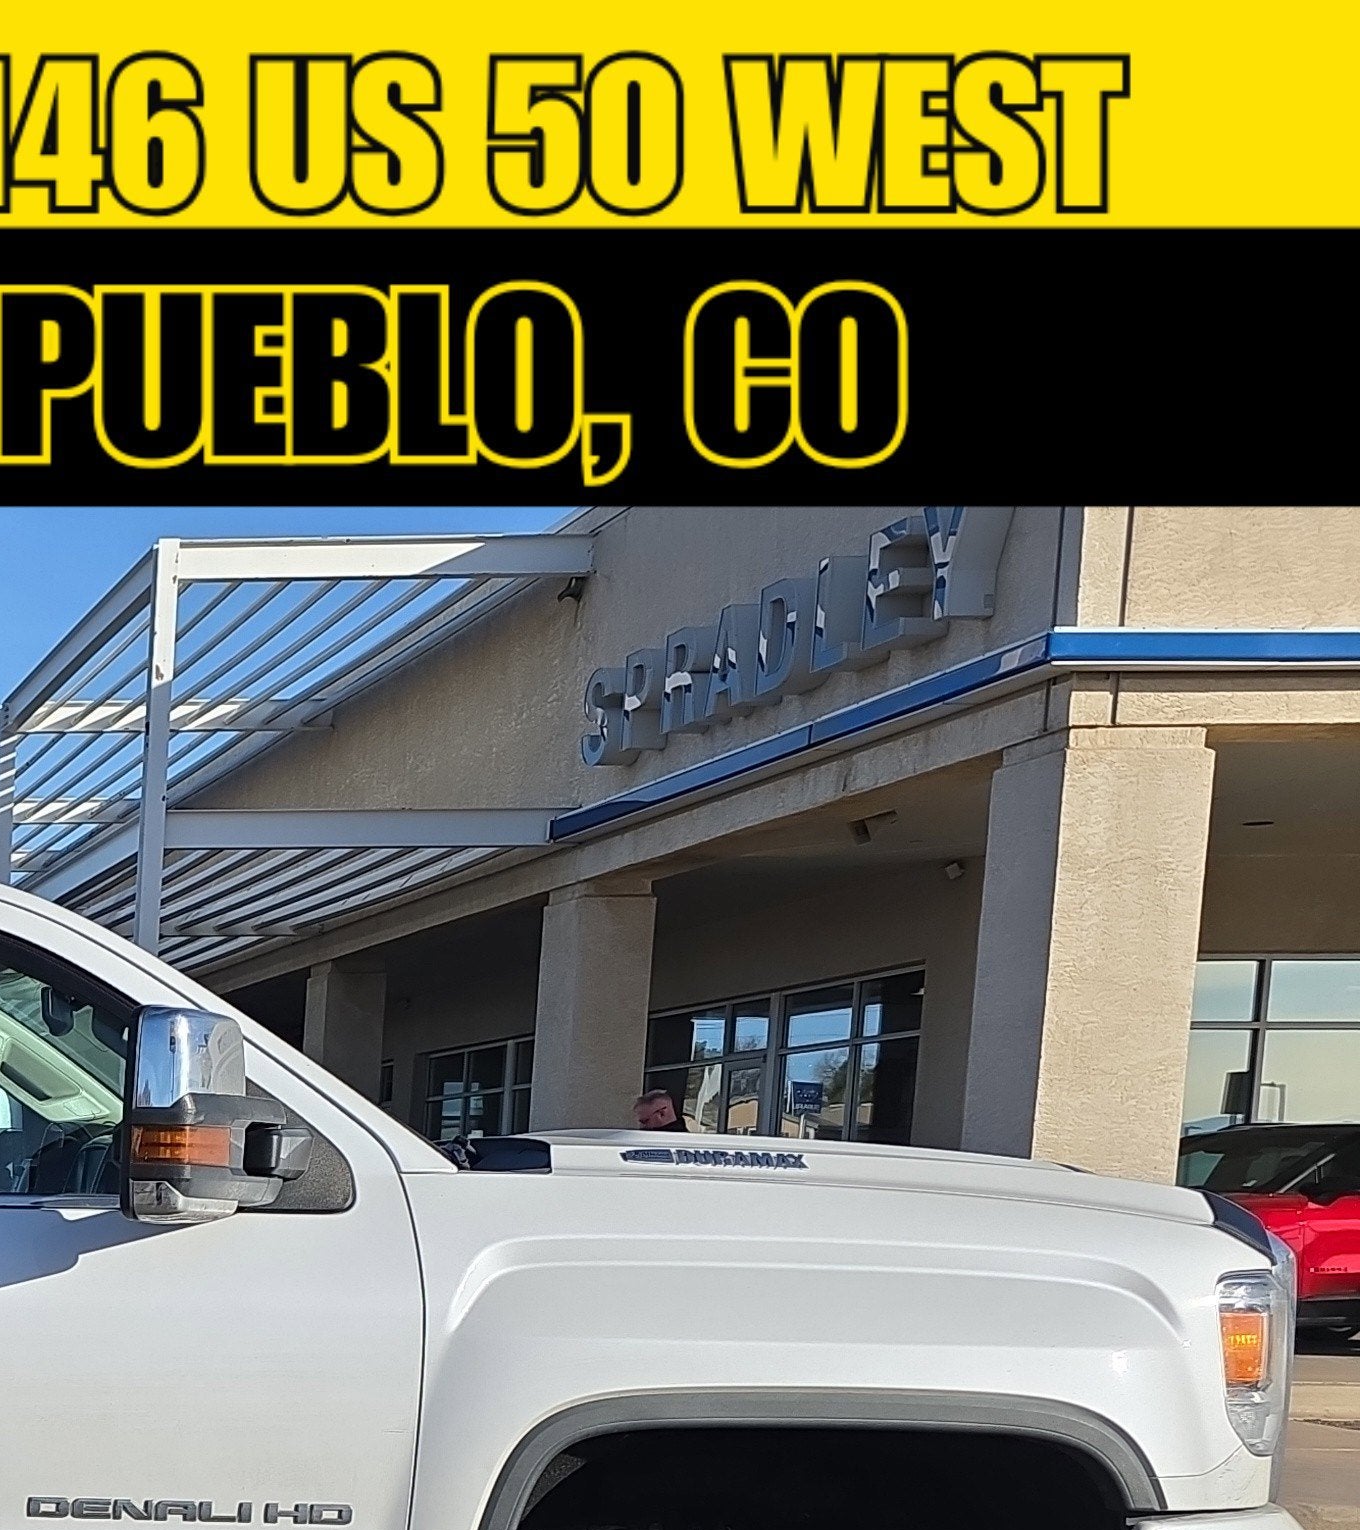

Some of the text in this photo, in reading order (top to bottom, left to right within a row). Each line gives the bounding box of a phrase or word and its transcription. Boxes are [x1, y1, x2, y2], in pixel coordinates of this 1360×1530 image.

[581, 506, 998, 768] SPRADLEY
[26, 1497, 354, 1525] DENALI HD
